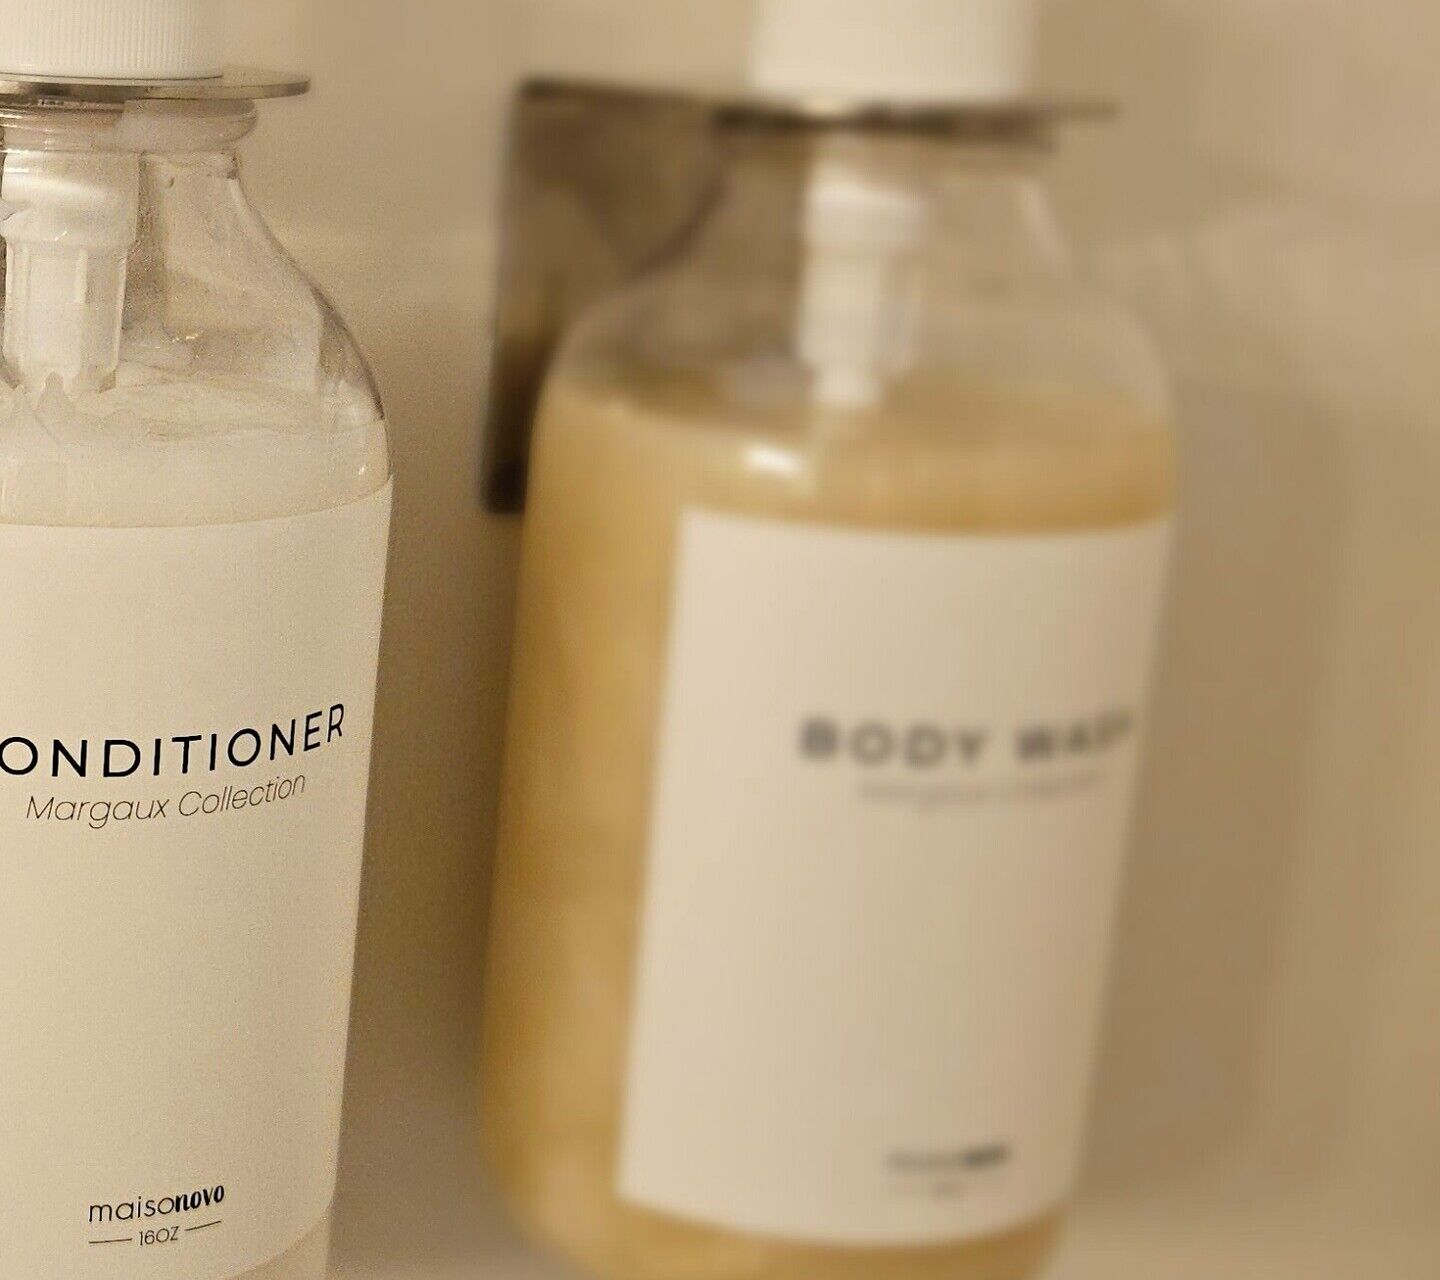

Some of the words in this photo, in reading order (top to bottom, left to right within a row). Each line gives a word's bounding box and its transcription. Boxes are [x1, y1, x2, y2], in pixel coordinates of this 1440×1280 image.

[797, 716, 990, 768] BODY
[1012, 707, 1137, 763] WA
[26, 790, 170, 829] Margaux
[178, 773, 307, 817] Collection
[89, 1185, 225, 1222] maisonovo
